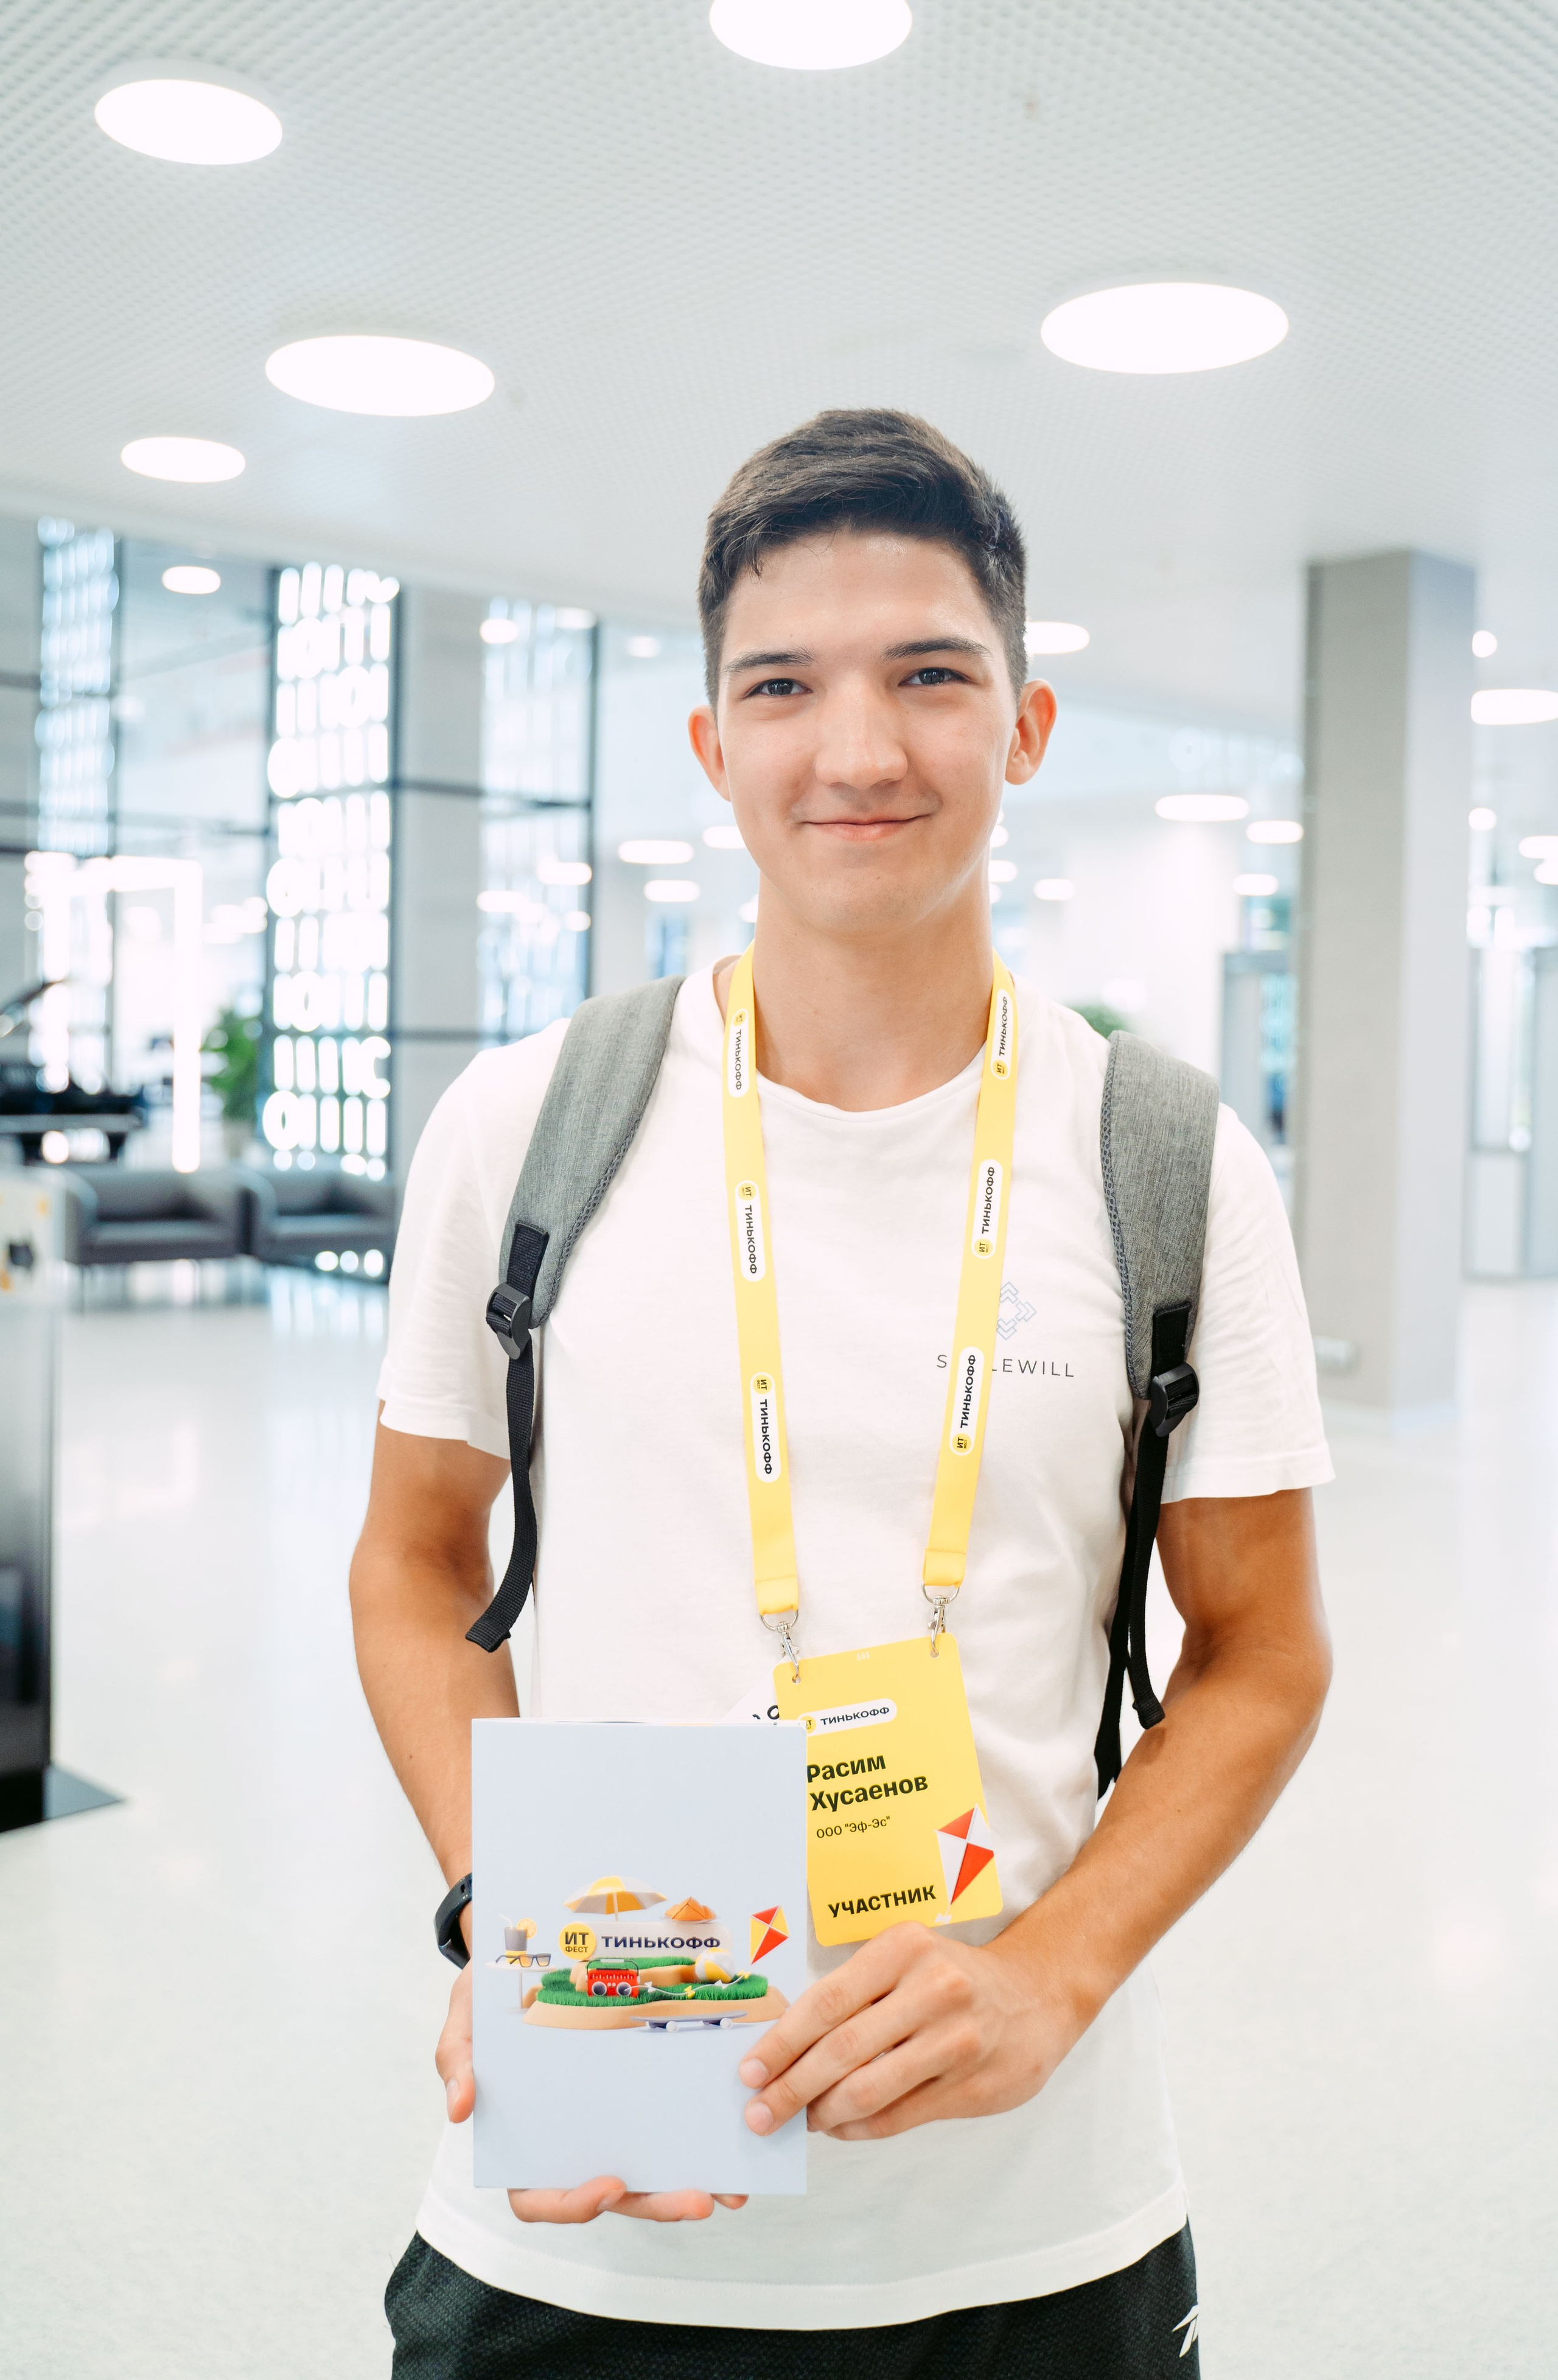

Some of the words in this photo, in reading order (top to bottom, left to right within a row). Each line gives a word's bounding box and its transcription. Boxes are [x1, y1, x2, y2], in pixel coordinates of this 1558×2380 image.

[999, 996, 1008, 1056] ТИНЬКОФФ
[745, 1187, 752, 1196] ИТ
[981, 1167, 995, 1234] ТИНЬКОФФ
[745, 1204, 758, 1274] ТИНЬКОФФ
[979, 1242, 985, 1252] ИТ
[760, 1379, 767, 1391] ИТ
[960, 1355, 976, 1429] ТИНЬКОФФ
[760, 1398, 773, 1474] ТИНЬКОФФ
[957, 1436, 964, 1449] ИТ
[820, 1706, 890, 1725] ТИНЬКОФФ
[806, 1755, 886, 1783] Расим
[809, 1775, 928, 1812] Хусаенов
[816, 1826, 842, 1838] ООО
[845, 1815, 890, 1833] "Эф-Эс"
[828, 1885, 936, 1918] УЧАСТНИК
[565, 1931, 589, 1946] ИТ
[601, 1936, 721, 1949] ТИНЬКОФФ
